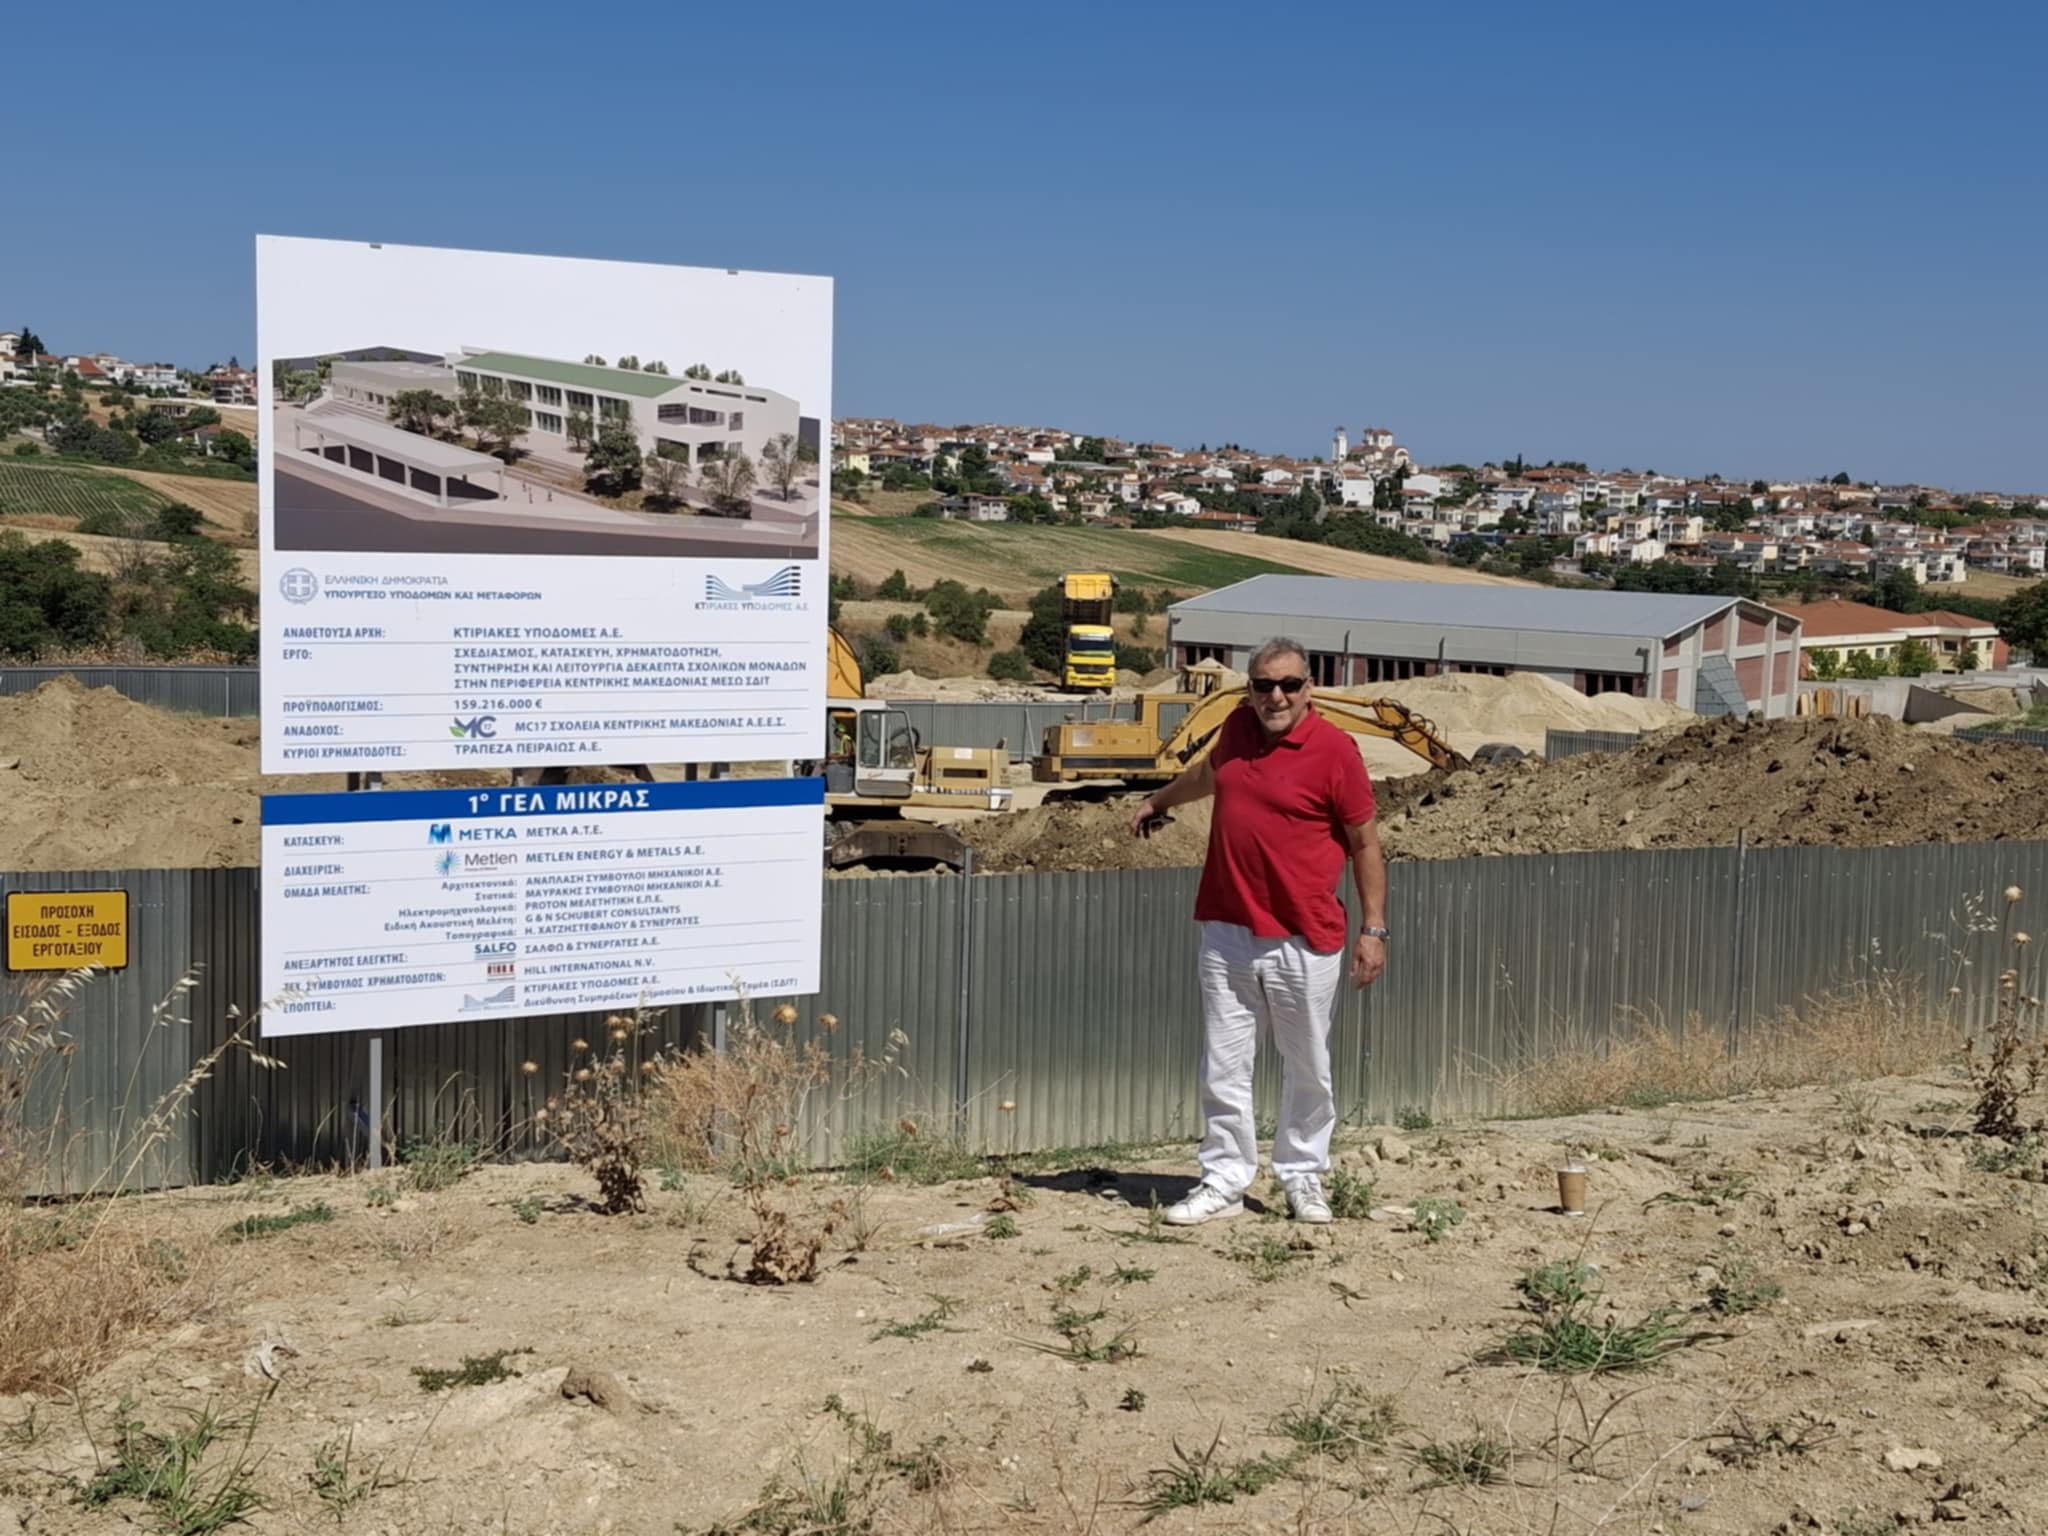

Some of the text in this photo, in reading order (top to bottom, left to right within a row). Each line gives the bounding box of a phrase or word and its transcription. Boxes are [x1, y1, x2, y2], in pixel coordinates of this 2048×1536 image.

[325, 575, 448, 585] ΕΛΛΗΝΙΚΗ ΔΗΜΟΚΡΑΤΙΑ
[324, 590, 541, 600] ΥΠΟΥΡΓΕΙΟ ΥΠΟΔΟΜΩΝ ΚΑΙ ΜΕΤΑΦΟΡΩΝ
[283, 628, 386, 638] ΑΝΑΘΕΤΟΥΣΑ ΑΡΧΗ:
[454, 628, 623, 638] ΚΤΙΡΙΑΚΕΣ ΥΠΟΔΟΜΕΣ Α.Ε.
[283, 650, 312, 660] ΕΡΓΟ:
[454, 648, 722, 659] ΣΧΕΔΙΑΣΜΟΣ, ΚΑΤΑΣΚΕΥΗ, ΧΡΗΜΑΤΟΔΟΤΗΣΗ,
[454, 662, 807, 673] ΣΥΝΤΗΡΗΣΗ ΚΑΙ ΛΕΙΤΟΥΡΓΙΑ ΔΕΚΑΕΠΤΑ ΣΧΟΛΙΚΩΝ ΜΟΝΑΔΩΝ
[454, 677, 770, 688] ΣΤΗΝ ΠΕΡΙΦΕΡΕΙΑ ΚΕΝΤΡΙΚΗΣ ΜΑΚΕΔΟΝΙΑΣ ΜΕΣΩ ΣΔΙΤ
[455, 700, 532, 709] 159.216.000
[515, 722, 547, 731] MC17
[550, 720, 600, 730] ΣΧΟΛΕΙΑ
[603, 720, 666, 729] ΚΕΝΤΡΙΚΗΣ
[669, 718, 743, 728] ΜΑΚΕΔΟΝΙΑΣ
[283, 726, 343, 736] ΑΝΑΔΟΧΟΣ:
[283, 746, 406, 758] ΚΥΡΙΟΙ ΧΡΗΜΑΤΟΔΟΤΕΣ:
[455, 742, 602, 754] ΤΡΑΠΕΖΑ ΠΕΙΡΑΙΩΣ Α.Ε.
[500, 793, 544, 813] ΓΕΛ
[556, 790, 649, 810] ΜΙΚΡΑΣ
[459, 827, 517, 841] METKA
[284, 836, 344, 847] ΚΑΤΑΣΚΕΥΗ:
[464, 853, 517, 866] Metlen
[526, 852, 574, 863] METLEN
[577, 850, 624, 860] ENERGY
[627, 850, 634, 858] &
[638, 847, 682, 858] METALS
[284, 865, 344, 876] ΔΙΑΧΕΙΡΙΣΗ:
[526, 875, 584, 885] ΑΝΑΠΛΑΣΗ
[586, 872, 645, 882] ΣΥΜΒΟΥΛΟΙ
[648, 870, 704, 880] ΜΗΧΑΝΙΚΟΙ
[284, 885, 370, 897] ΟΜΑΔΑ ΜΕΛΕΤΗΣ:
[526, 888, 582, 898] ΜΑΥΡΑΚΗΣ
[586, 885, 644, 894] ΣΥΜΒΟΥΛΟΙ
[647, 882, 702, 892] ΜΗΧΑΝΙΚΟΙ
[526, 900, 568, 910] PROTON
[41, 905, 94, 919] ΠΡΟΣΟΧΗ
[555, 910, 608, 920] SCHUBERT
[610, 906, 680, 917] CONSULTANTS
[640, 917, 700, 928] ΣΥΝΕΡΓΑΤΕΣ
[13, 924, 61, 938] ΕΙΣΟΔΟΣ
[77, 923, 121, 936] ΕΞΟΔΟΣ
[33, 942, 102, 956] ΕΡΓΟΤΑΞΙΟΥ
[475, 942, 516, 954] SALFO
[576, 938, 638, 950] ΣΥΝΕΡΓΑΤΕΣ
[284, 953, 408, 970] ΑΝΕΞΑΡΤΗΤΟΣ ΕΛΕΓΚΤΗΣ:
[524, 966, 547, 975] HILL
[550, 960, 632, 973] INTERNATIONAL
[368, 972, 446, 987] ΧΡΗΜΑΤΟΔΟΤΩΝ:
[524, 982, 578, 994] ΚΤΙΡΙΑΚΕΣ
[580, 977, 638, 988] ΥΠΟΔΟΜΕΣ
[284, 1001, 336, 1013] ΕΠΟΠΤΕΙΑ:
